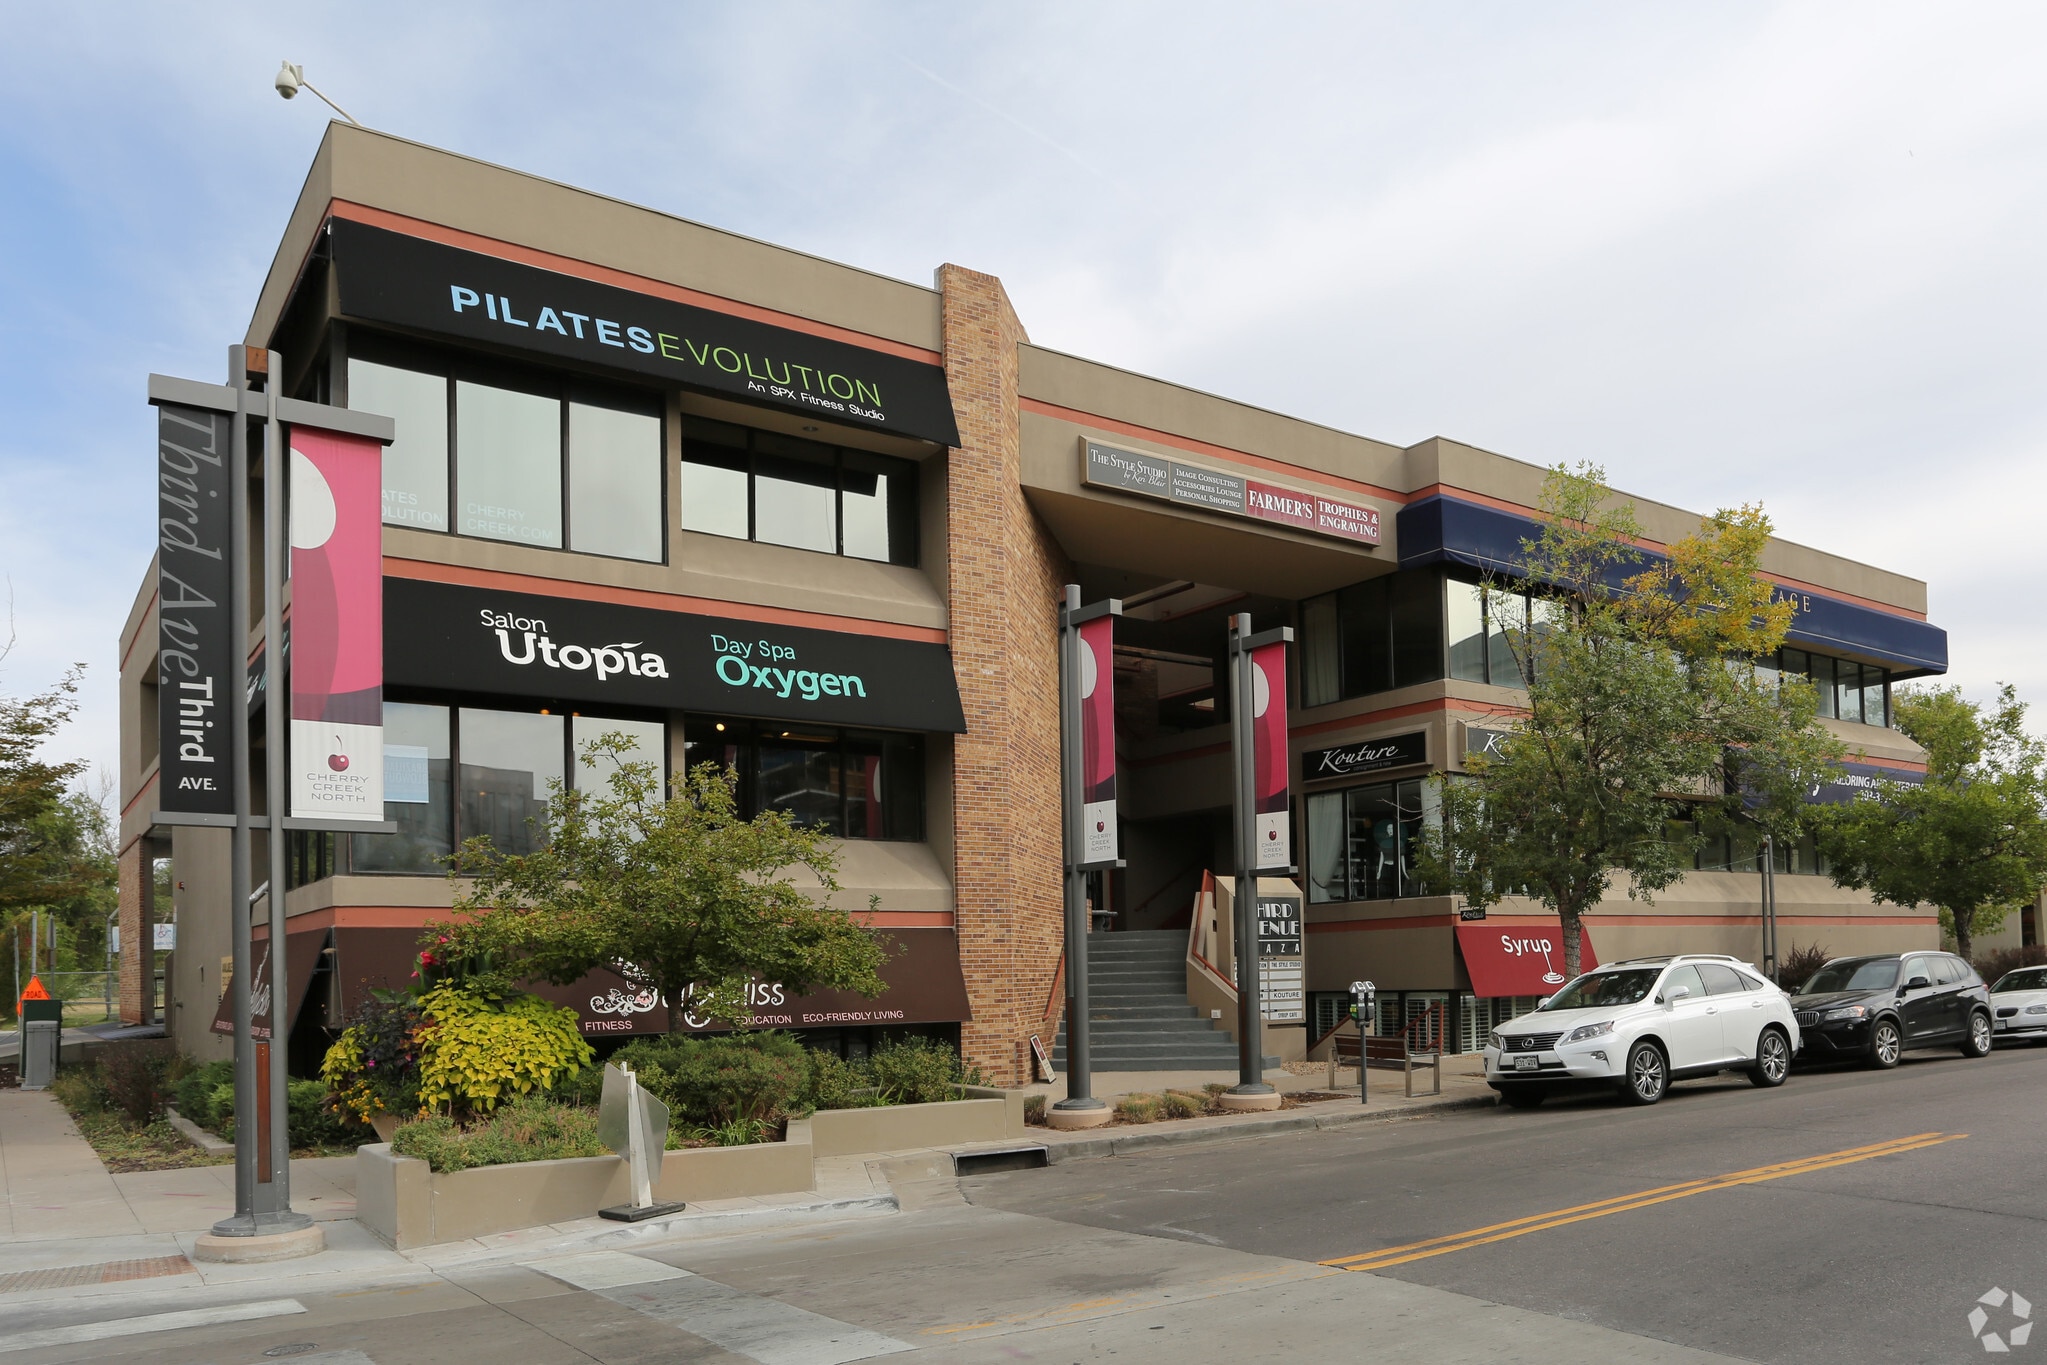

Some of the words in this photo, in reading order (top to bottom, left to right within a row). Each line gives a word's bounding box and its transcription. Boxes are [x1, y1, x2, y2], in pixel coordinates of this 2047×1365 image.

[747, 381, 766, 393] An
[770, 385, 797, 400] SPX
[800, 392, 845, 412] Fitness
[848, 404, 885, 421] Studio
[1090, 449, 1109, 466] THE
[1110, 453, 1136, 472] STYLE
[1137, 461, 1167, 479] STUDIO
[160, 407, 223, 561] Third
[1121, 469, 1131, 486] by
[1131, 472, 1147, 485] Keri
[1148, 475, 1166, 488] Blair
[1172, 478, 1215, 493] ACCESSORIES
[1216, 486, 1243, 499] LOUNGE
[1176, 468, 1198, 480] IMAGE
[1198, 473, 1239, 489] CONSULTING
[382, 488, 418, 505] ATES
[1175, 488, 1209, 502] PERSONAL
[1209, 494, 1240, 508] SHOPPING
[1248, 489, 1314, 520] FARMER'S
[382, 504, 443, 525] OLUTION
[466, 502, 526, 521] CHERRY
[1317, 500, 1369, 523] TROPHIES
[1371, 513, 1378, 525] &
[1319, 515, 1378, 538] ENGRAVING
[160, 565, 217, 685] Ave.
[479, 609, 548, 634] Salon
[495, 628, 669, 682] Utopia
[710, 634, 753, 659] Day
[758, 639, 797, 663] Spa
[715, 655, 867, 702] Oxygen
[178, 676, 215, 764] Third
[1317, 744, 1400, 773] Kouture
[178, 776, 218, 792] AVE.
[306, 772, 369, 784] CHERRY
[312, 783, 364, 793] CREEK
[310, 791, 367, 803] NORTH
[1090, 844, 1112, 852] NORTH
[1256, 903, 1293, 918] HIRD
[1258, 920, 1300, 936] ENUE
[1500, 934, 1552, 958] Syrup
[585, 1020, 633, 1032] FITNESS
[802, 1011, 872, 1023] ECO-FRIENDLY
[873, 1010, 904, 1020] LIVING
